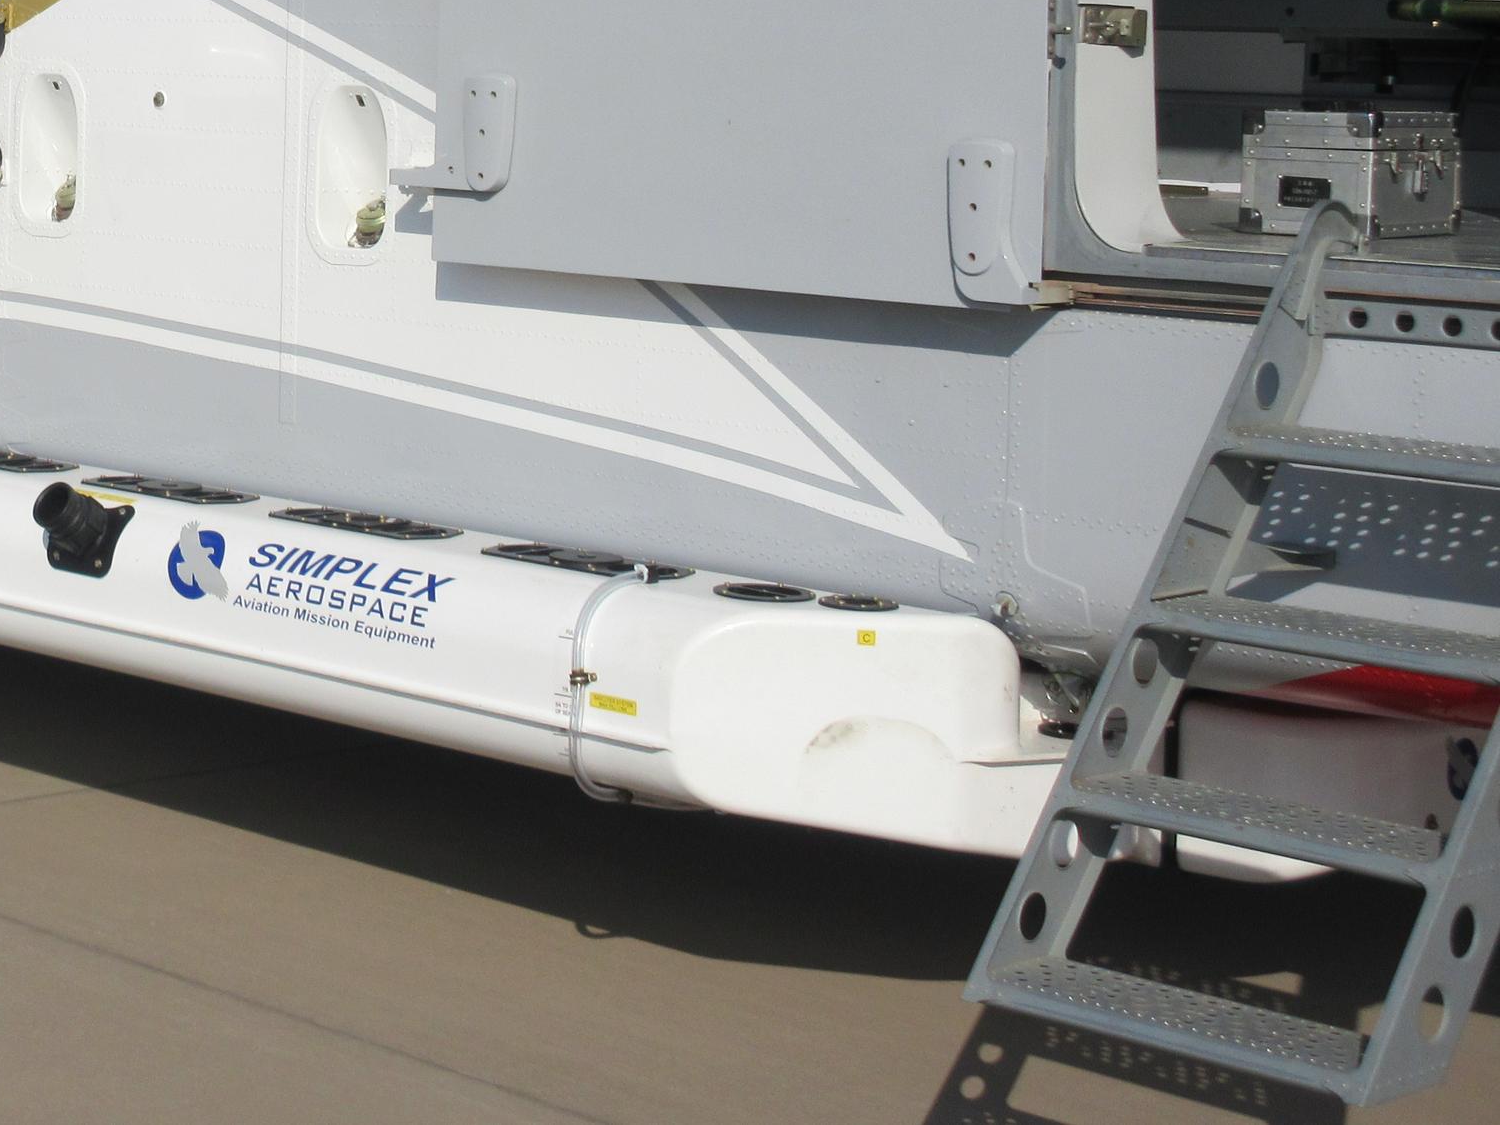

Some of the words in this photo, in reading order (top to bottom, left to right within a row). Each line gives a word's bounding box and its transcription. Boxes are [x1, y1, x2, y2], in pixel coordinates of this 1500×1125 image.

[246, 573, 429, 628] AEROSPACE
[248, 543, 456, 603] SIMPLEX
[233, 595, 289, 618] Aviation
[294, 607, 349, 630] Mission
[354, 621, 436, 649] Equipment
